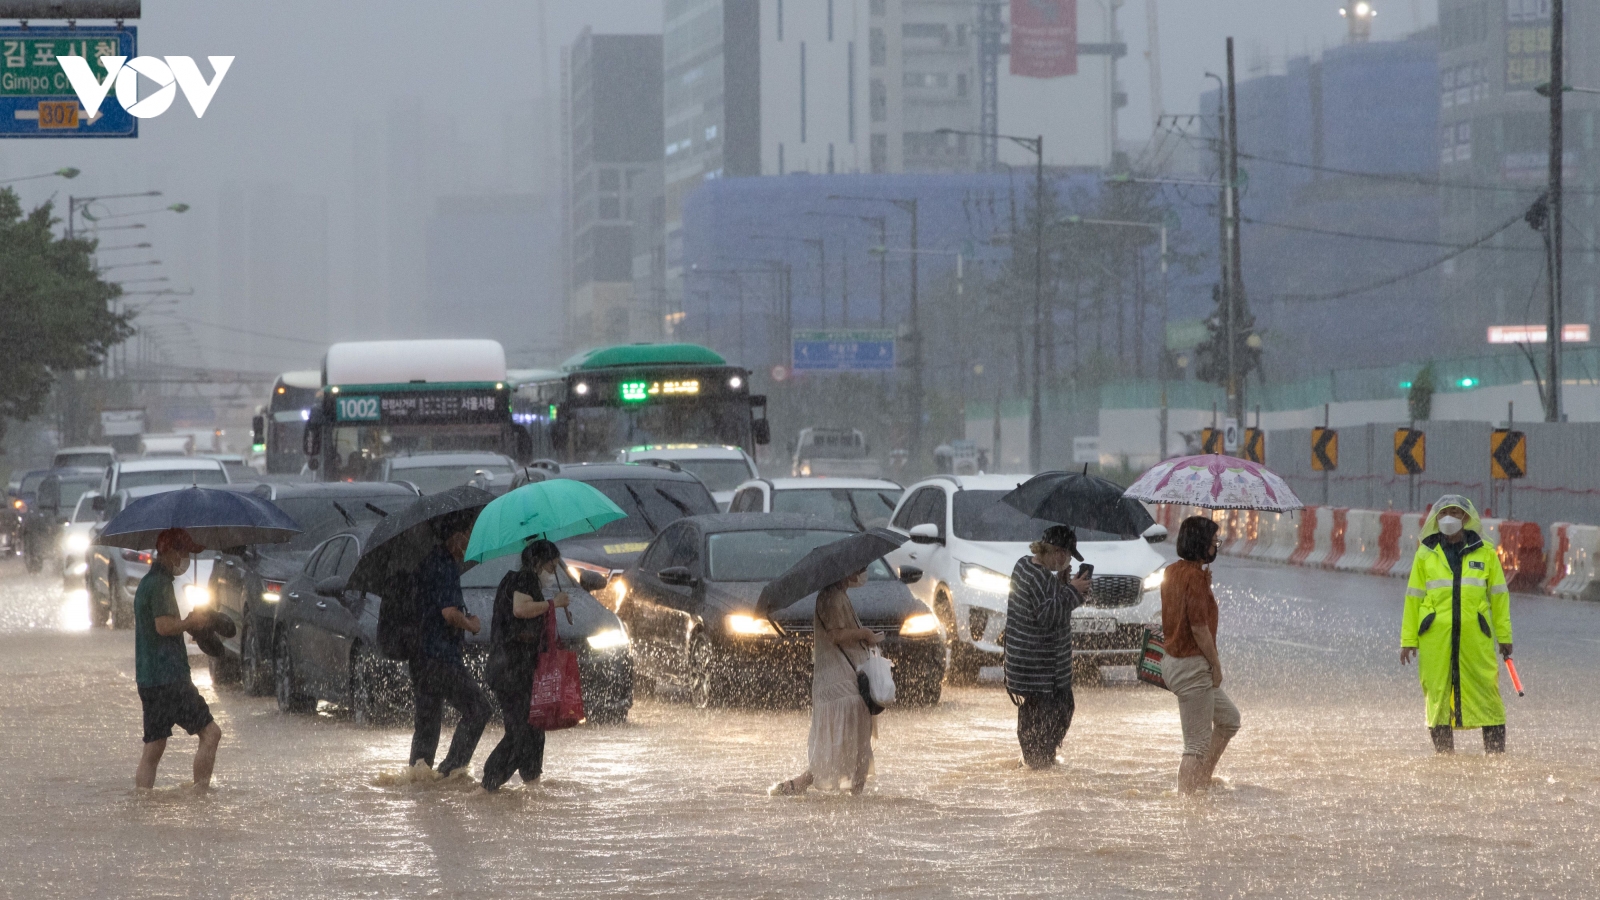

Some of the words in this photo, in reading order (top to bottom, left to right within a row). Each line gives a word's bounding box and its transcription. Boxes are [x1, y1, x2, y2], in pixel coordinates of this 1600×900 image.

[2, 72, 49, 93] Gimpo
[42, 105, 77, 124] 307
[340, 398, 378, 418] 1002
[461, 396, 496, 411] 서울시청
